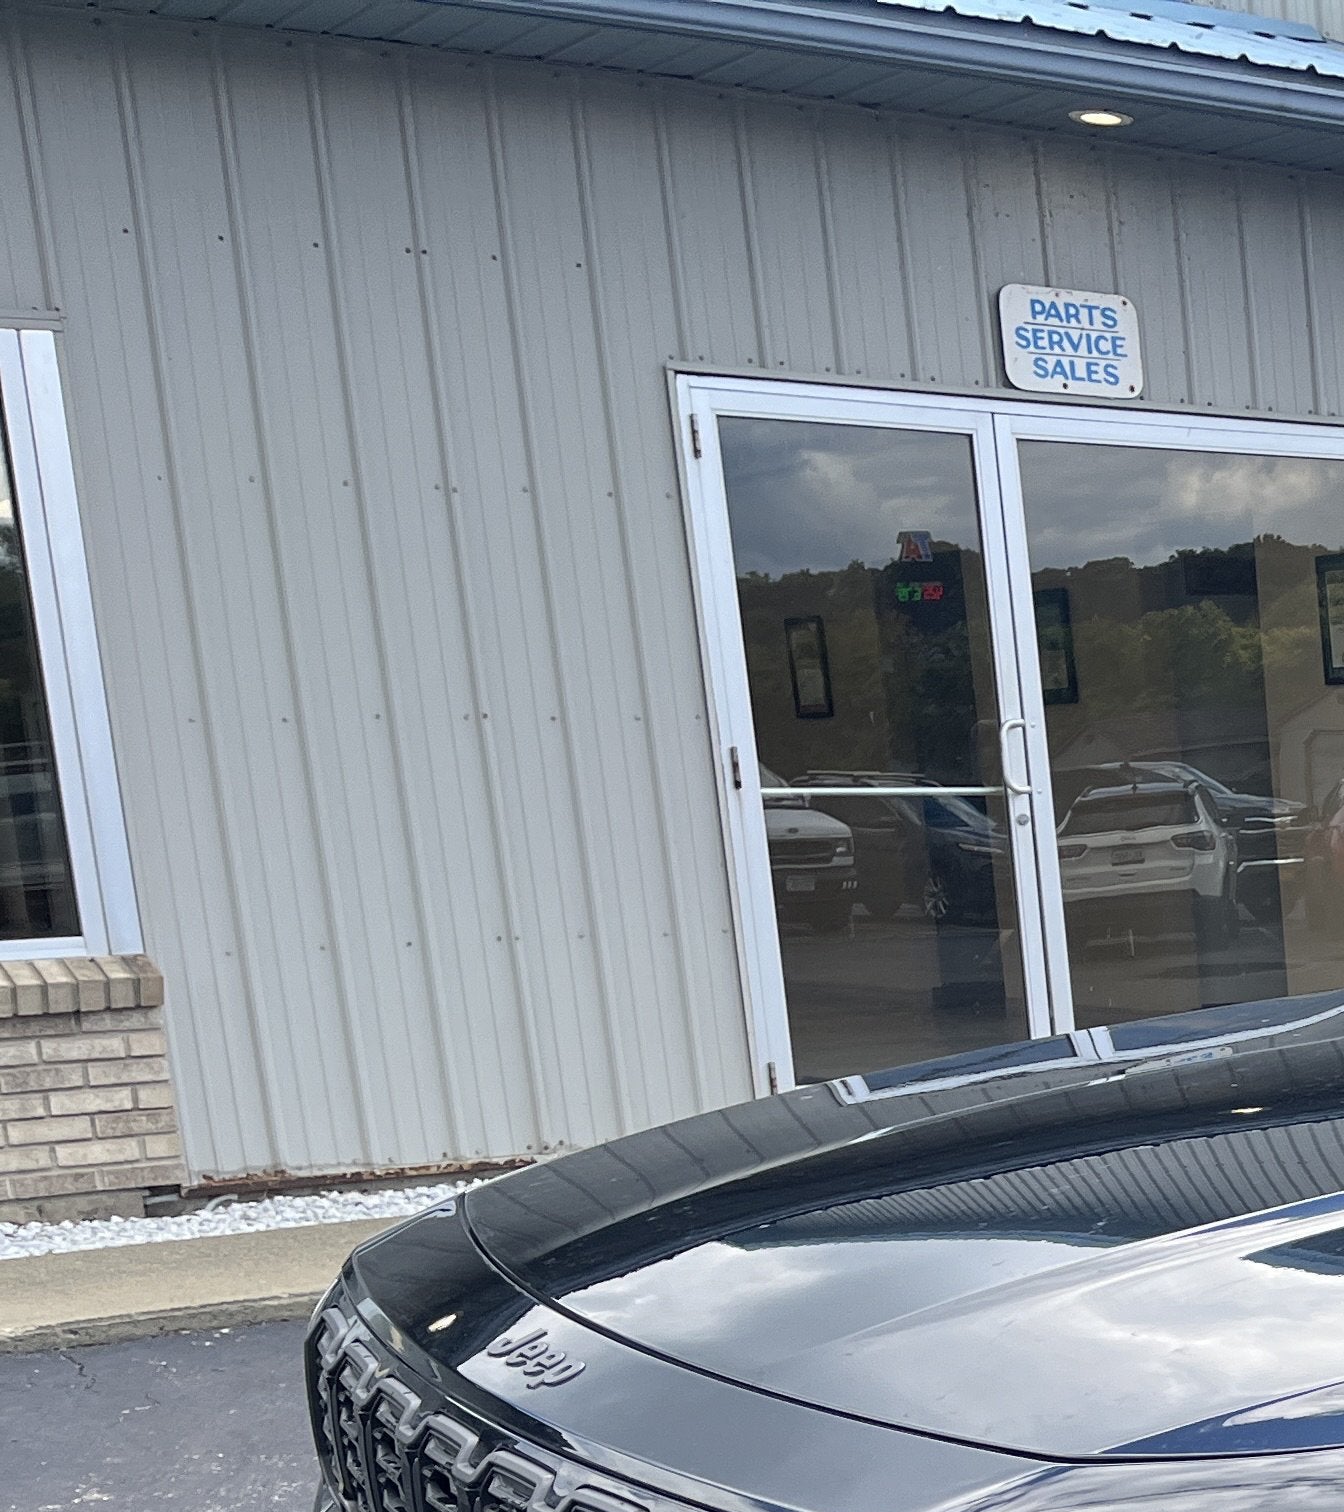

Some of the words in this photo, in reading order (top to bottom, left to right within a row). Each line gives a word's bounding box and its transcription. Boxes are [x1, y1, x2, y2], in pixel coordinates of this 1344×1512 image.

[1030, 299, 1118, 329] PARTS
[1015, 326, 1128, 358] SERVICE
[1033, 357, 1120, 386] SALES
[487, 1327, 587, 1390] Jeep
